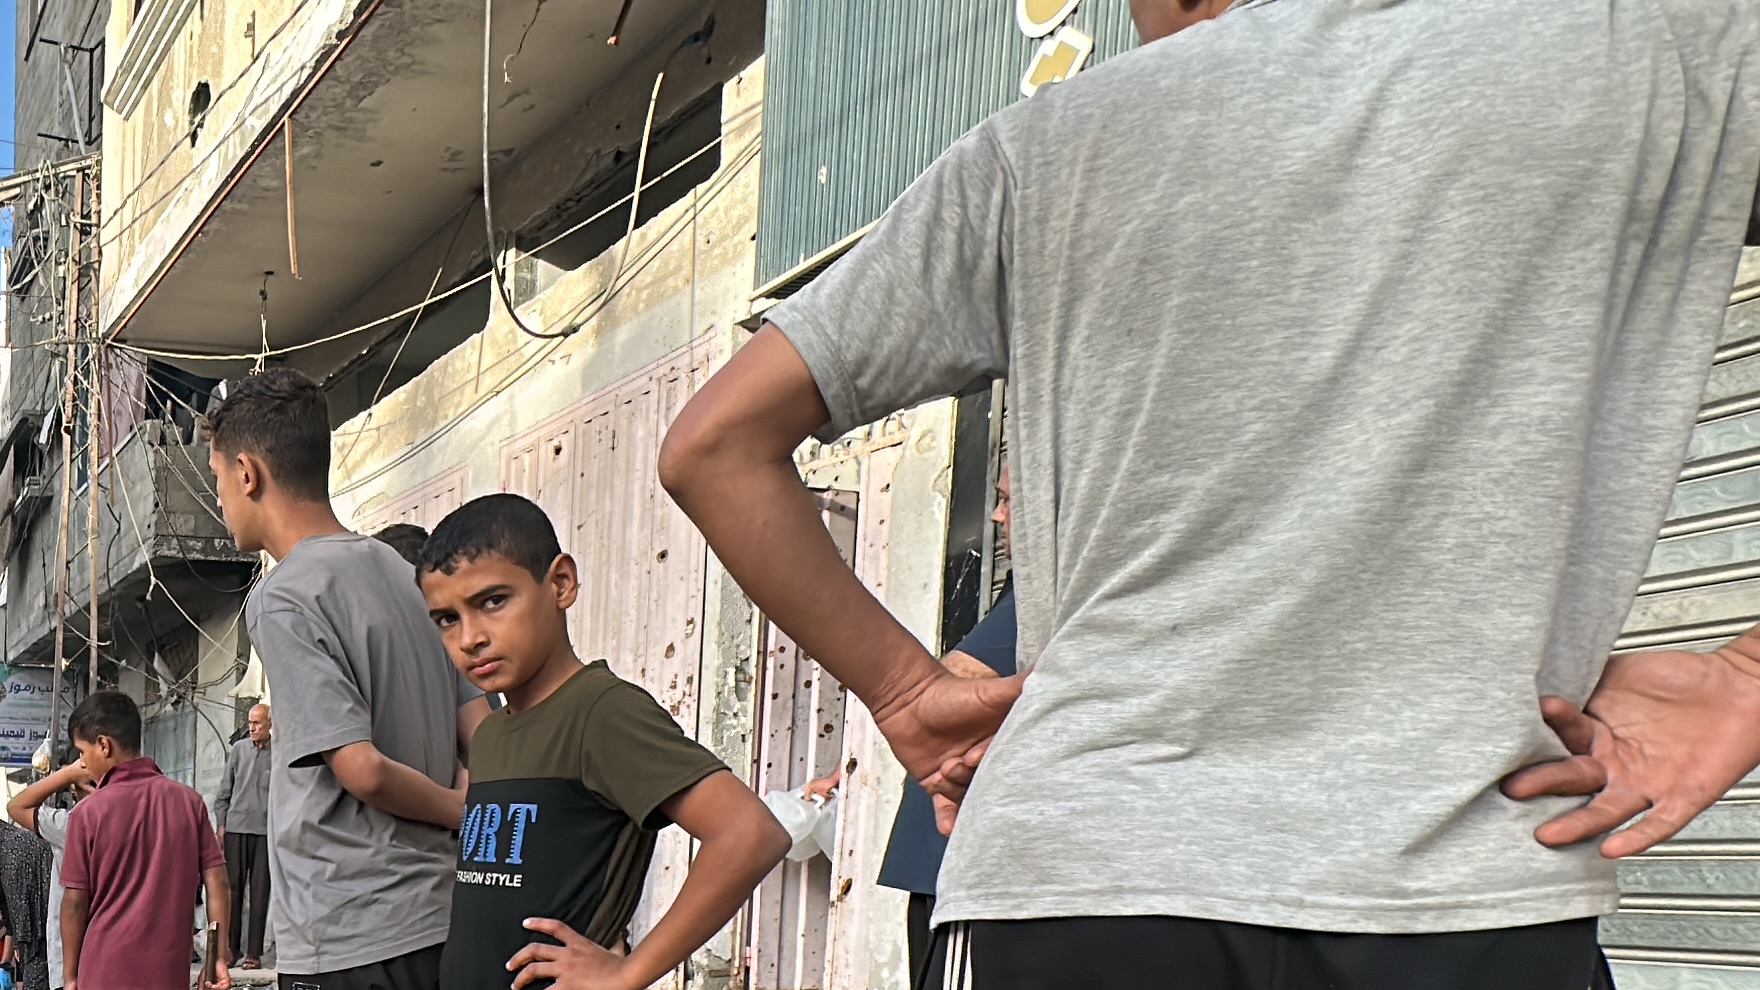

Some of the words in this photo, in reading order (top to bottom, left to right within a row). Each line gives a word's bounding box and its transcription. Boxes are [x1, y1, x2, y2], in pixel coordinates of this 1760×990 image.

[8, 681, 36, 695] رموز
[459, 803, 538, 864] ORT
[484, 872, 523, 887] STYLE
